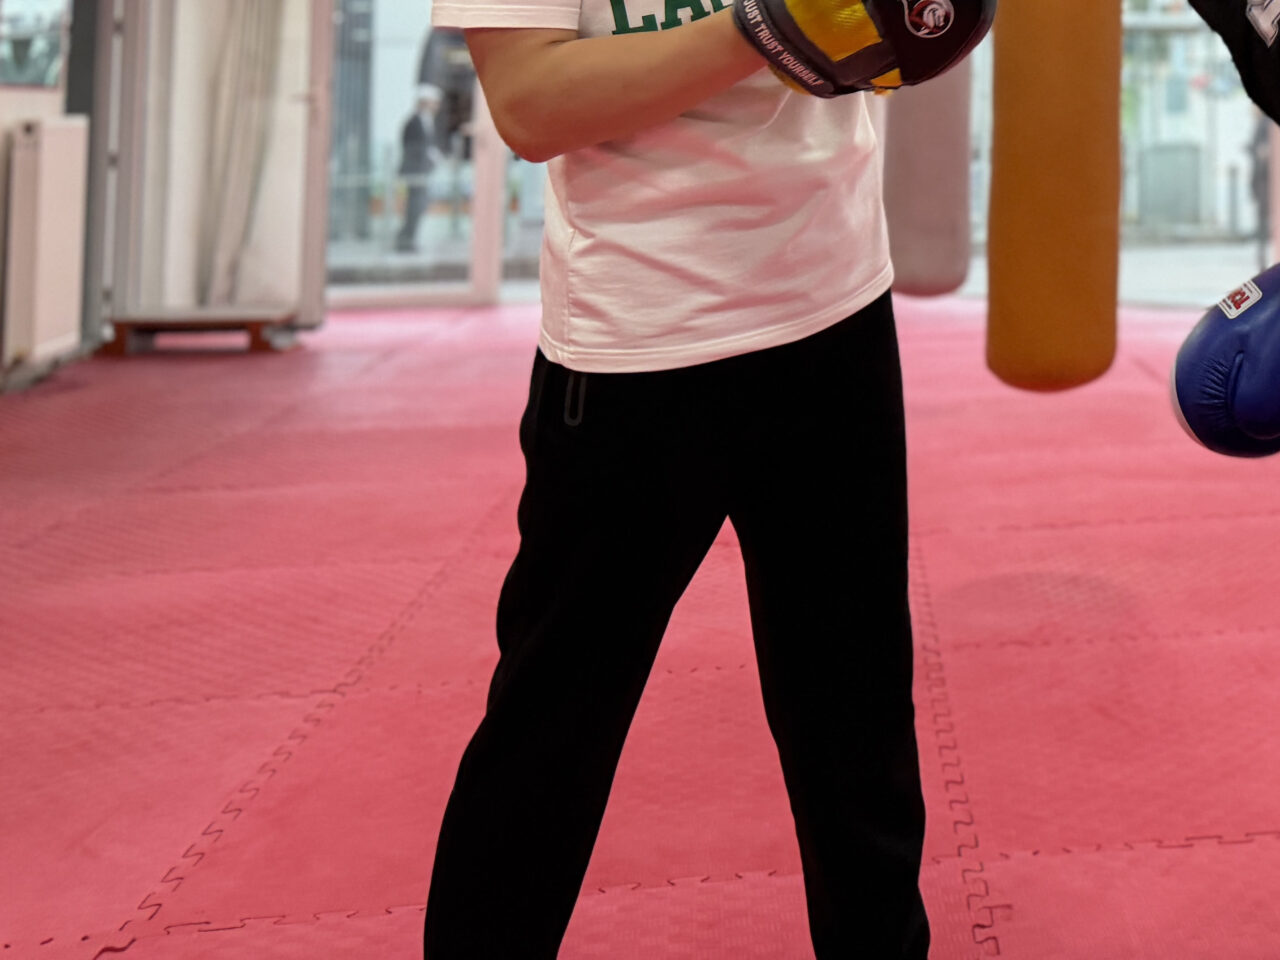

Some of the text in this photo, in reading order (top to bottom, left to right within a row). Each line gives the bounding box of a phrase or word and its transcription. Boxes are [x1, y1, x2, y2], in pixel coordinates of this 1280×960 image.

[743, 0, 824, 86] JUST TRUST YOURSELF
